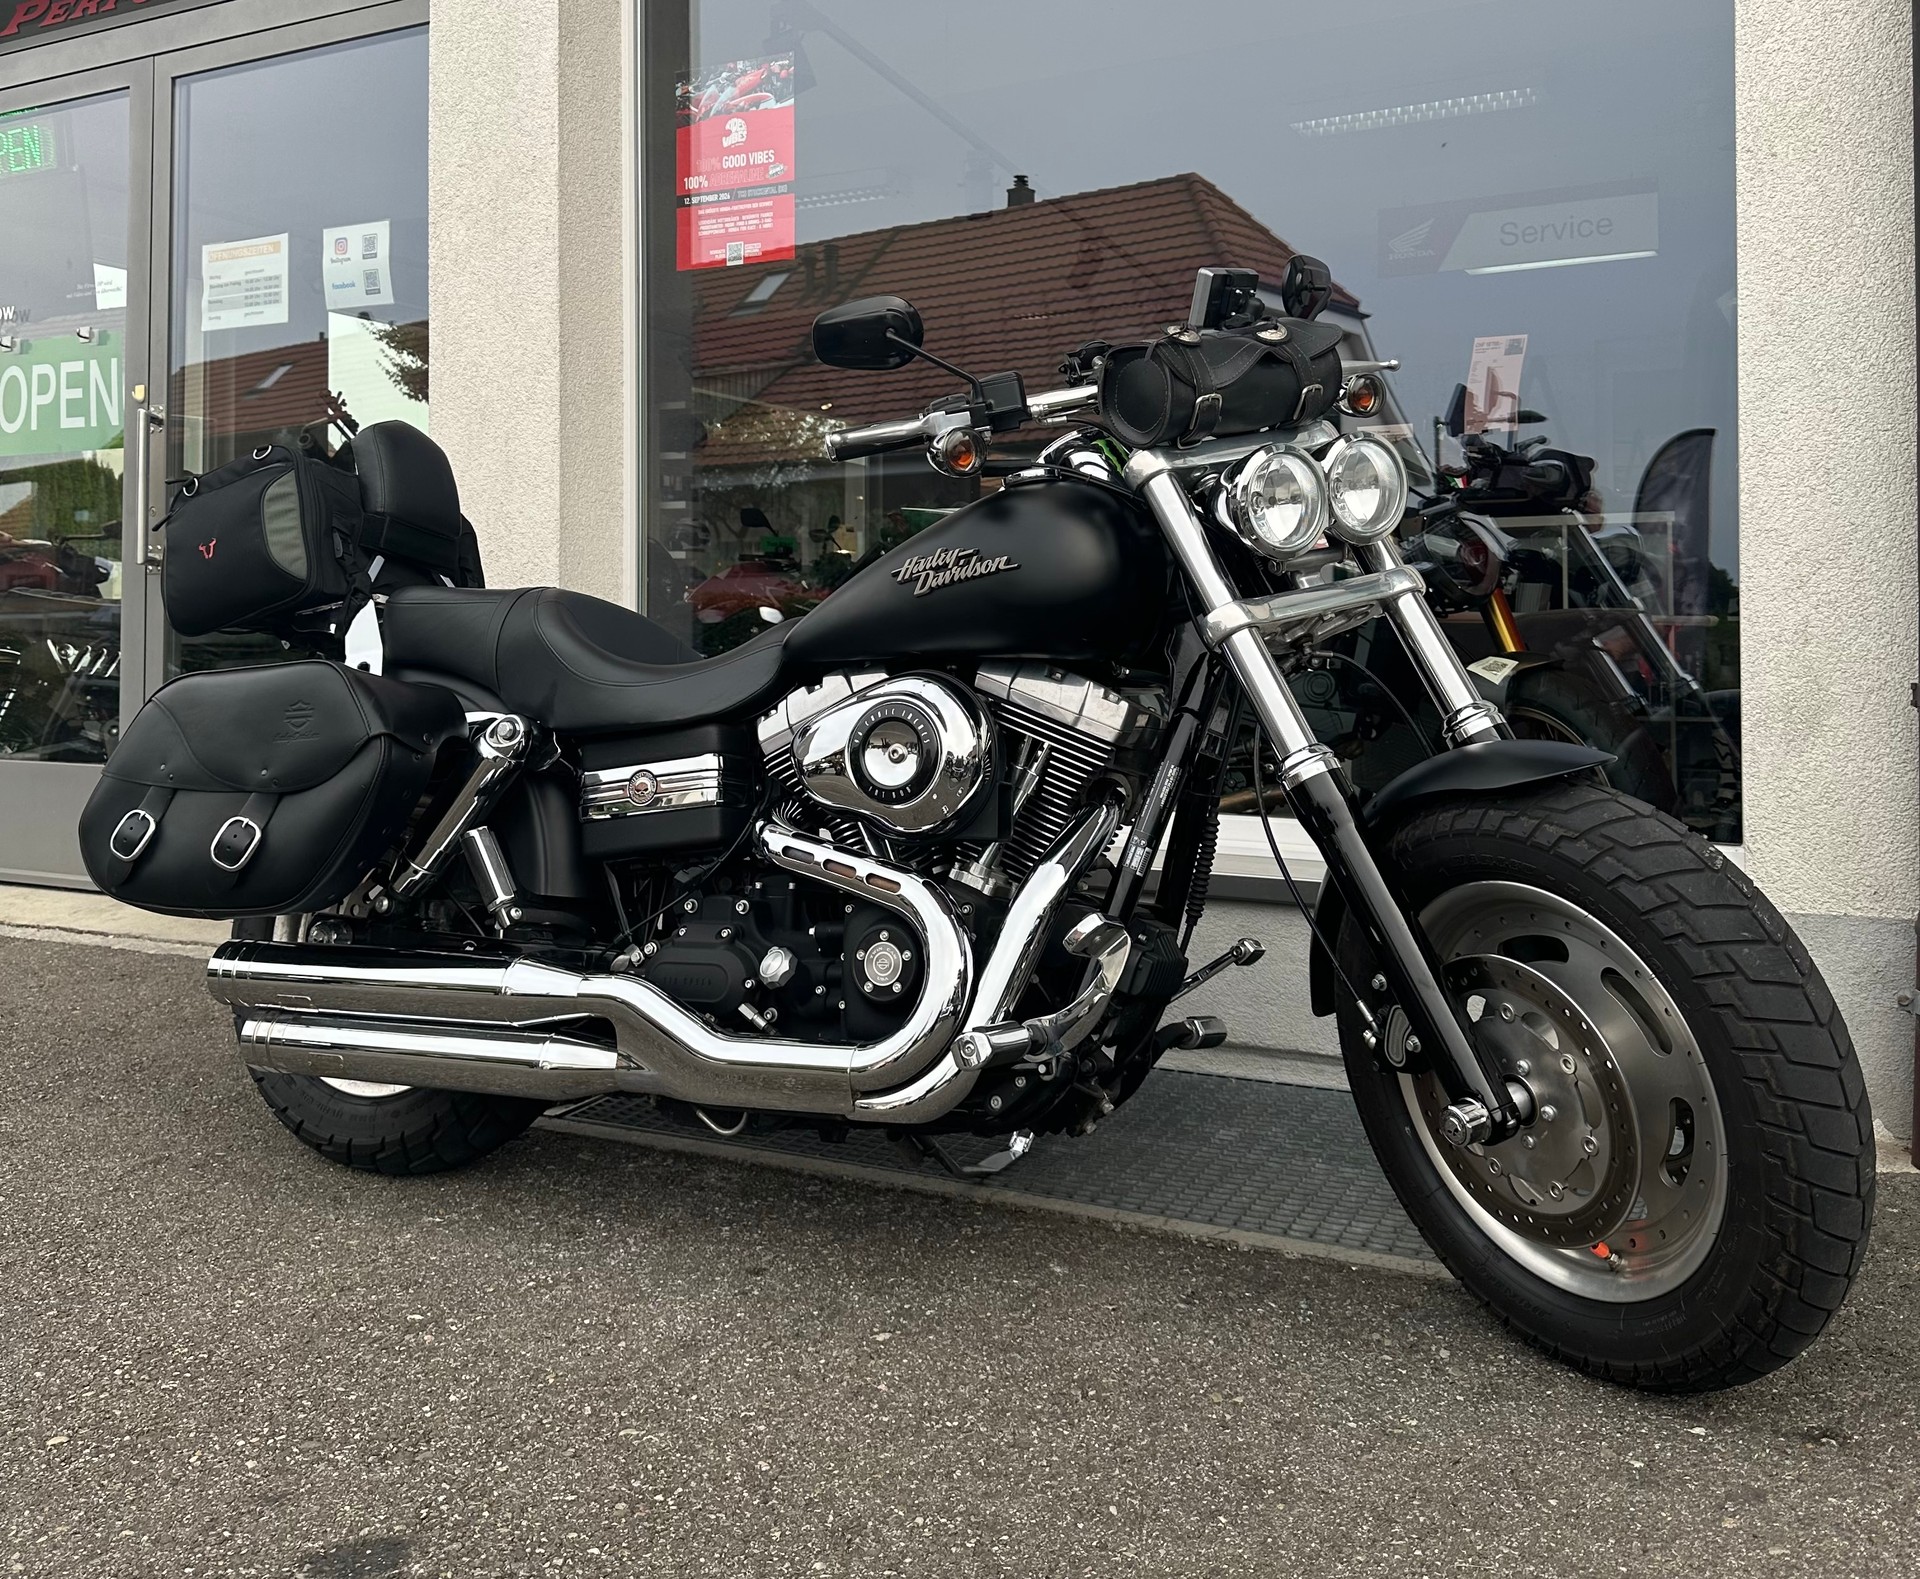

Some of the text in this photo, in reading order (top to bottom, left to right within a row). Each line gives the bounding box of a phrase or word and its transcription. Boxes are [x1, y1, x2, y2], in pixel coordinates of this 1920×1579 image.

[722, 153, 747, 169] GOOD
[749, 149, 775, 166] VIBES
[683, 175, 709, 191] 100%
[691, 193, 719, 204] SEPTEMBER
[1499, 214, 1613, 247] Service
[1388, 249, 1436, 261] HONDA
[0, 357, 120, 434] OPEN
[912, 555, 1020, 597] Davidson
[870, 946, 898, 960] TWIN CAM
